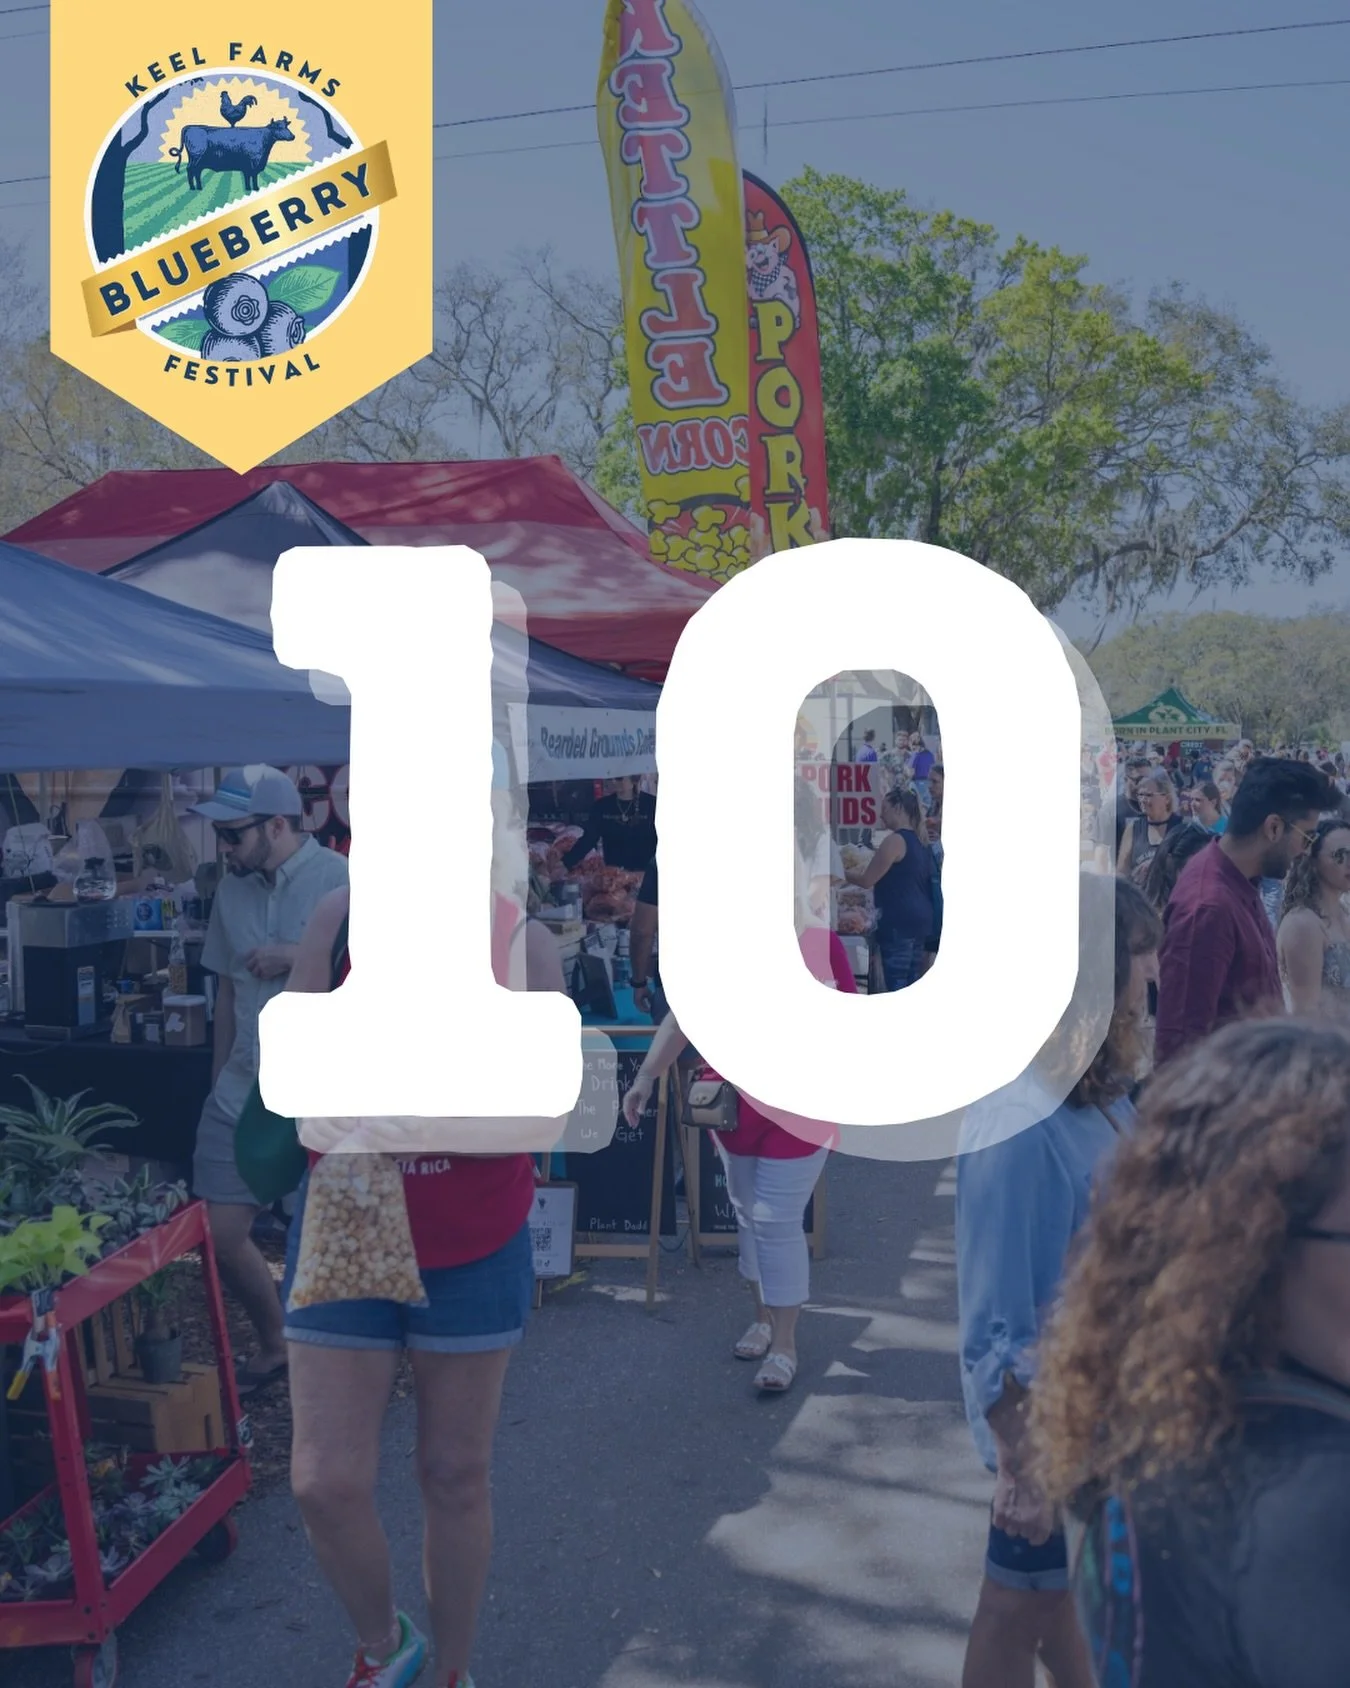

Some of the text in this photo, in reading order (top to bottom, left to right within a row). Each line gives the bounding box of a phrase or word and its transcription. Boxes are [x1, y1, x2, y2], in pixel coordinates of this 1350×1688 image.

[753, 299, 816, 552] PORK
[1136, 726, 1147, 735] IN
[1150, 726, 1182, 735] PLANT
[590, 727, 635, 758] Grounds
[801, 764, 871, 792] PORK
[629, 1057, 642, 1072] Yo
[591, 1073, 631, 1091] Drink
[615, 1126, 644, 1143] Get
[420, 1157, 451, 1176] RICA
[589, 1216, 618, 1230] Plant
